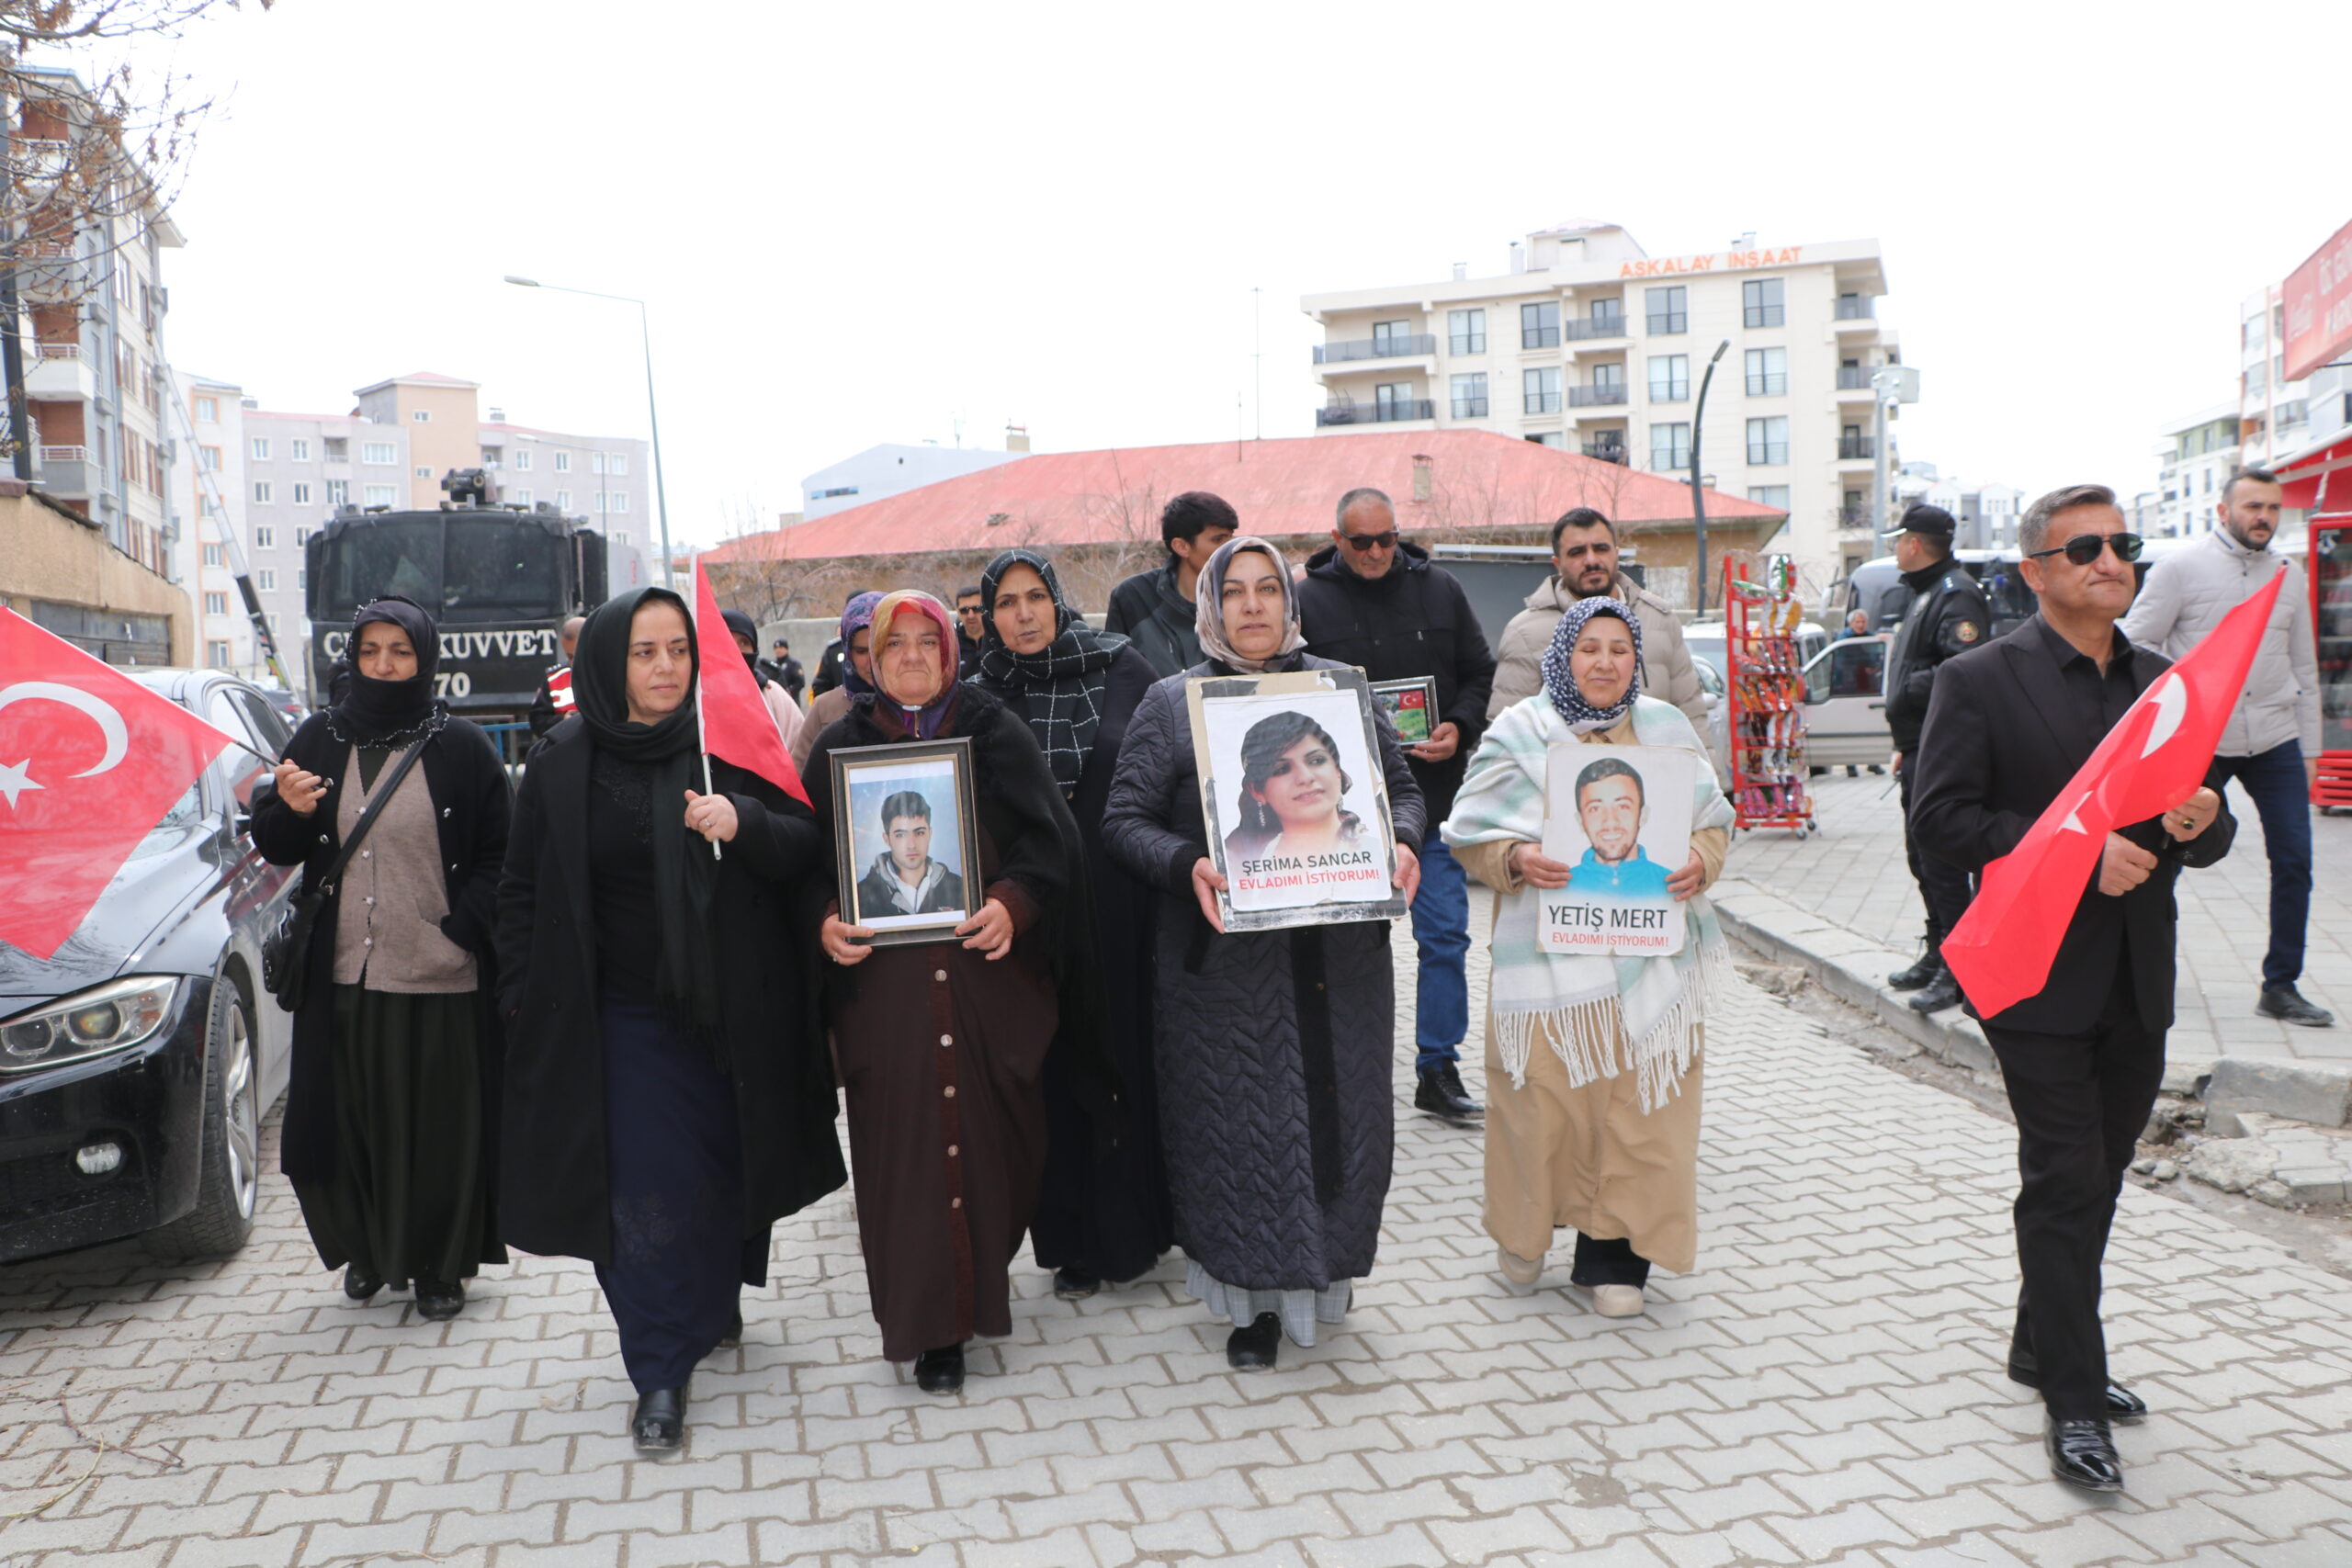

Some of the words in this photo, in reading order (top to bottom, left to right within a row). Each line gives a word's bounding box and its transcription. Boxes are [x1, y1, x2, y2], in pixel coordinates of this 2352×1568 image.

[439, 629, 557, 659] KUVVET
[434, 671, 470, 698] 70
[1242, 855, 1303, 876] ŞERİMA
[1307, 851, 1373, 868] SANCAR
[1238, 877, 1303, 890] EVLADIMI
[1306, 869, 1380, 885] İSTİYORUM!
[1548, 902, 1604, 932] YETİŞ
[1611, 908, 1668, 929] MERT
[1552, 932, 1603, 945] EVLADIMI
[1607, 932, 1668, 947] İSTİYORUM!
